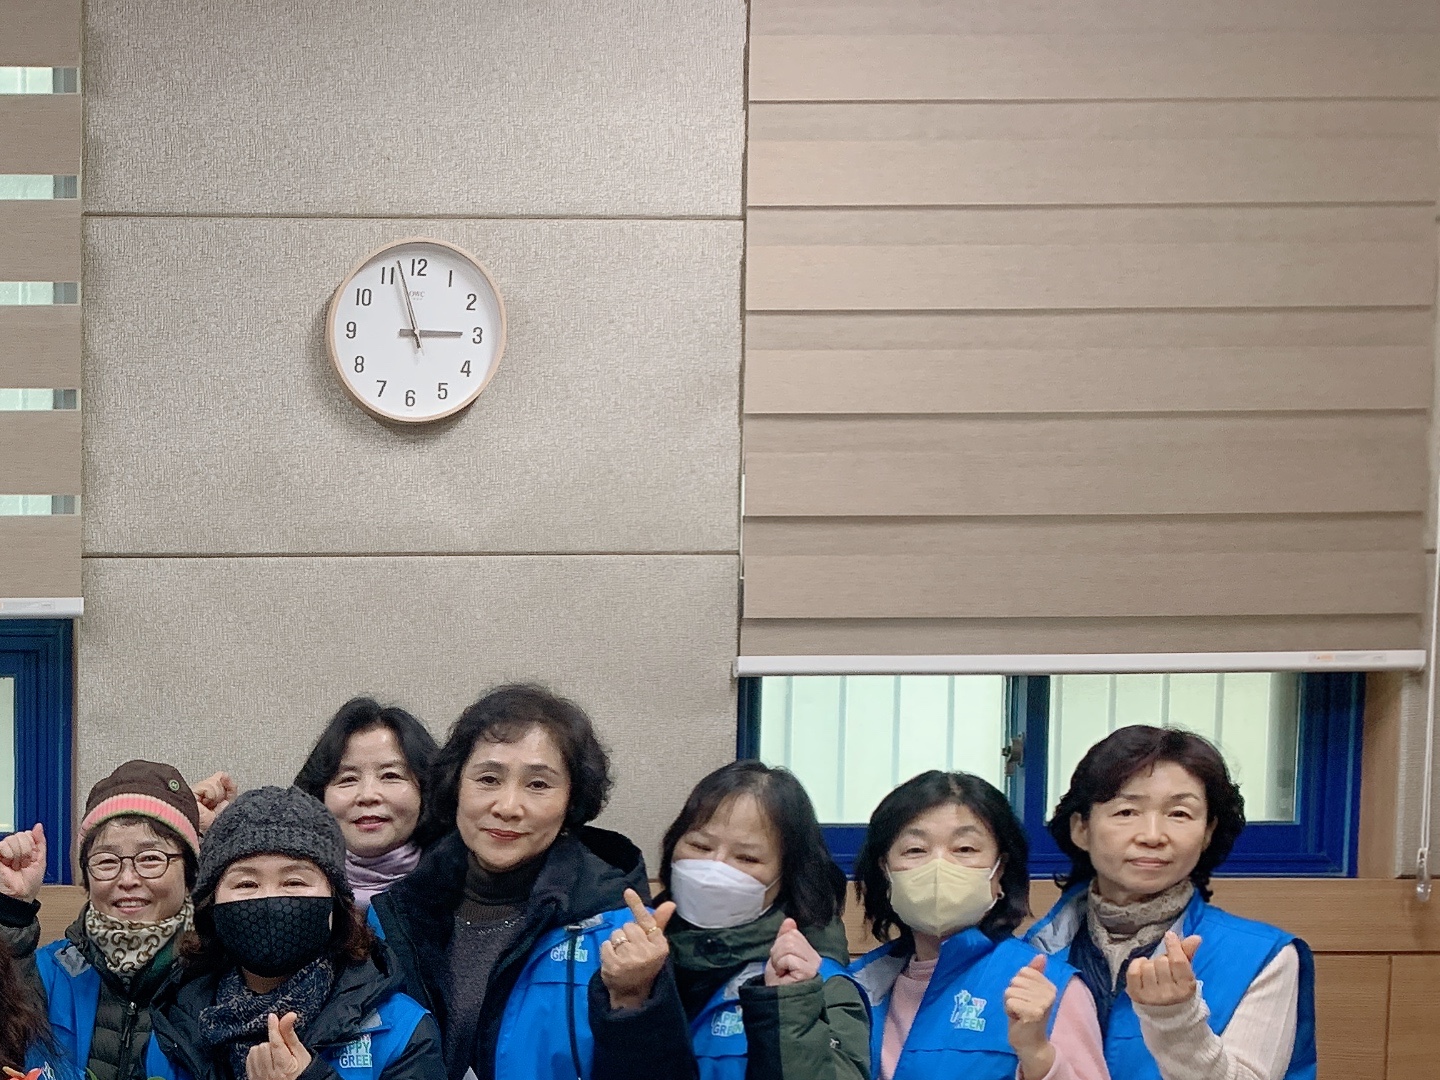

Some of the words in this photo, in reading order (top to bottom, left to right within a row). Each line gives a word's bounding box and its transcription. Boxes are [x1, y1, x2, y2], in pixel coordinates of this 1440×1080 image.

[381, 266, 395, 285] 11
[411, 258, 428, 277] 12
[448, 269, 453, 288] 1
[355, 287, 372, 306] 10
[465, 293, 477, 311] 2
[345, 321, 357, 339] 9
[472, 326, 483, 345] 3
[354, 355, 365, 374] 8
[460, 360, 472, 378] 4
[376, 379, 387, 398] 7
[405, 389, 416, 407] 6
[437, 382, 449, 400] 5
